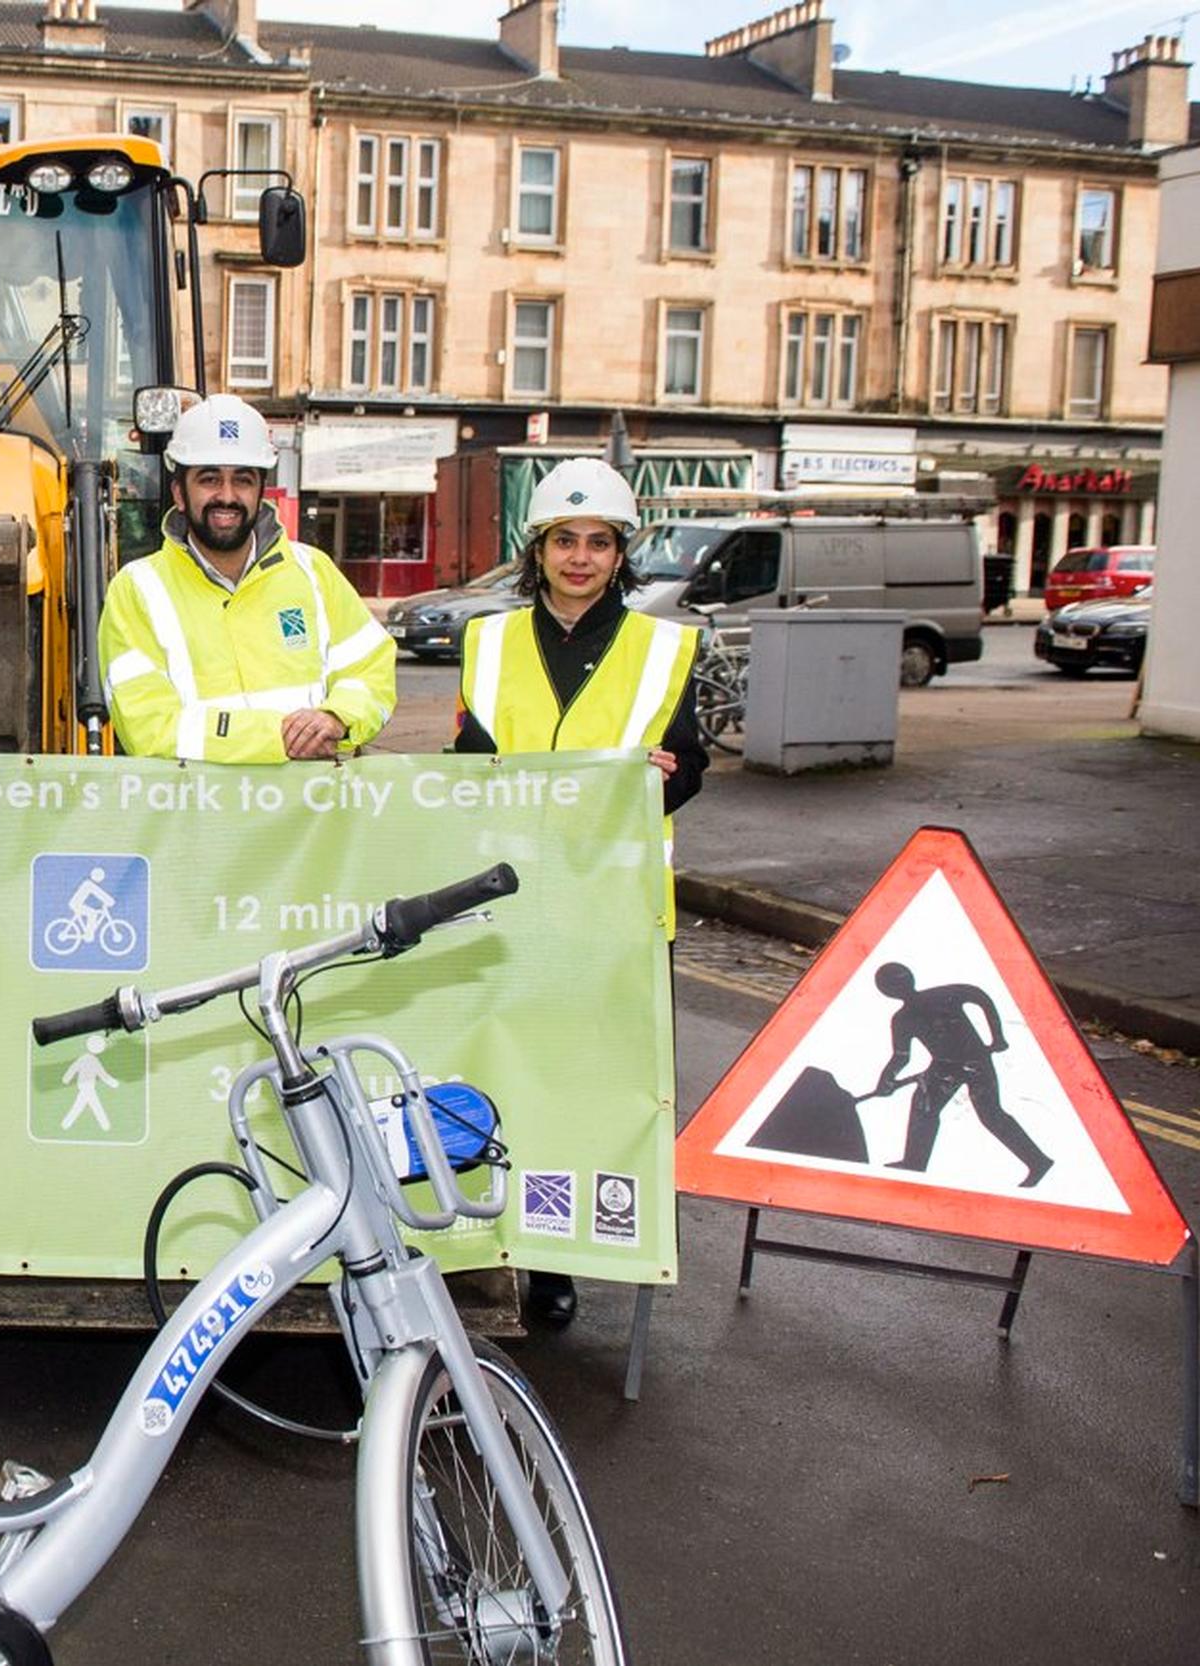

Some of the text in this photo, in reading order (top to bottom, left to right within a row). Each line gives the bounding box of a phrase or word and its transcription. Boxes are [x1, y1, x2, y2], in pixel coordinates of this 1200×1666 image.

[831, 458, 898, 472] ELECTRICS
[121, 774, 220, 812] Park
[240, 776, 284, 812] to
[303, 771, 393, 816] City
[412, 769, 581, 808] Centre
[213, 893, 262, 931] 12
[161, 1292, 247, 1397] 47491
